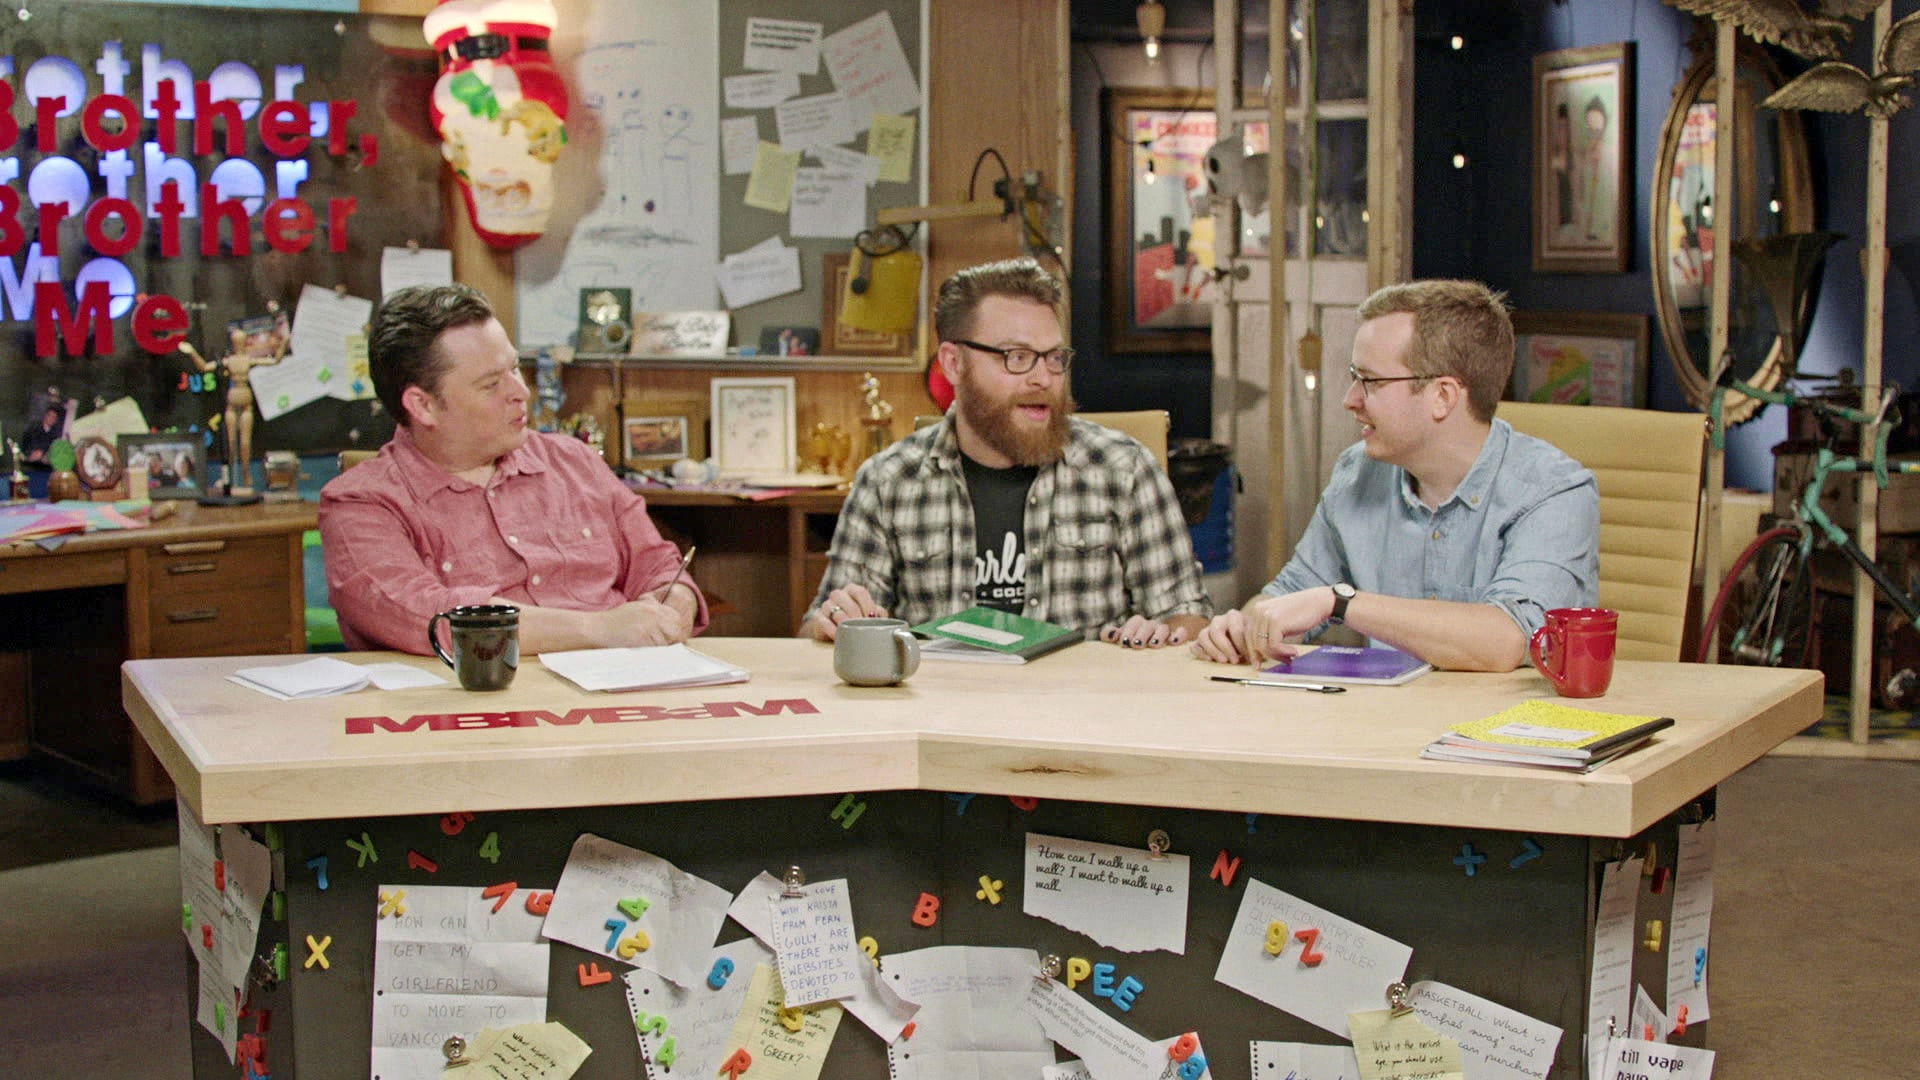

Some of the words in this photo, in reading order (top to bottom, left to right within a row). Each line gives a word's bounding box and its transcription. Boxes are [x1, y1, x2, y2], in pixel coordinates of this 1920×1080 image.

[35, 281, 190, 357] Me
[1038, 844, 1065, 859] How
[1067, 853, 1087, 864] can
[1098, 856, 1124, 869] walk
[1126, 864, 1140, 875] up
[1141, 864, 1150, 873] a
[1078, 870, 1106, 883] want
[1108, 872, 1119, 884] to
[1121, 876, 1149, 890] walk
[1150, 884, 1164, 896] up
[1165, 884, 1174, 893] a
[911, 892, 940, 927] B
[440, 916, 467, 929] CAN
[393, 945, 425, 958] GET
[450, 945, 473, 959] MY
[788, 957, 844, 976] WEBSITES
[391, 976, 498, 992] GIRLFRIEND
[790, 973, 838, 990] DEVOTED
[798, 987, 830, 1002] HER?
[428, 1004, 465, 1018] MOVE
[488, 1005, 507, 1019] TO
